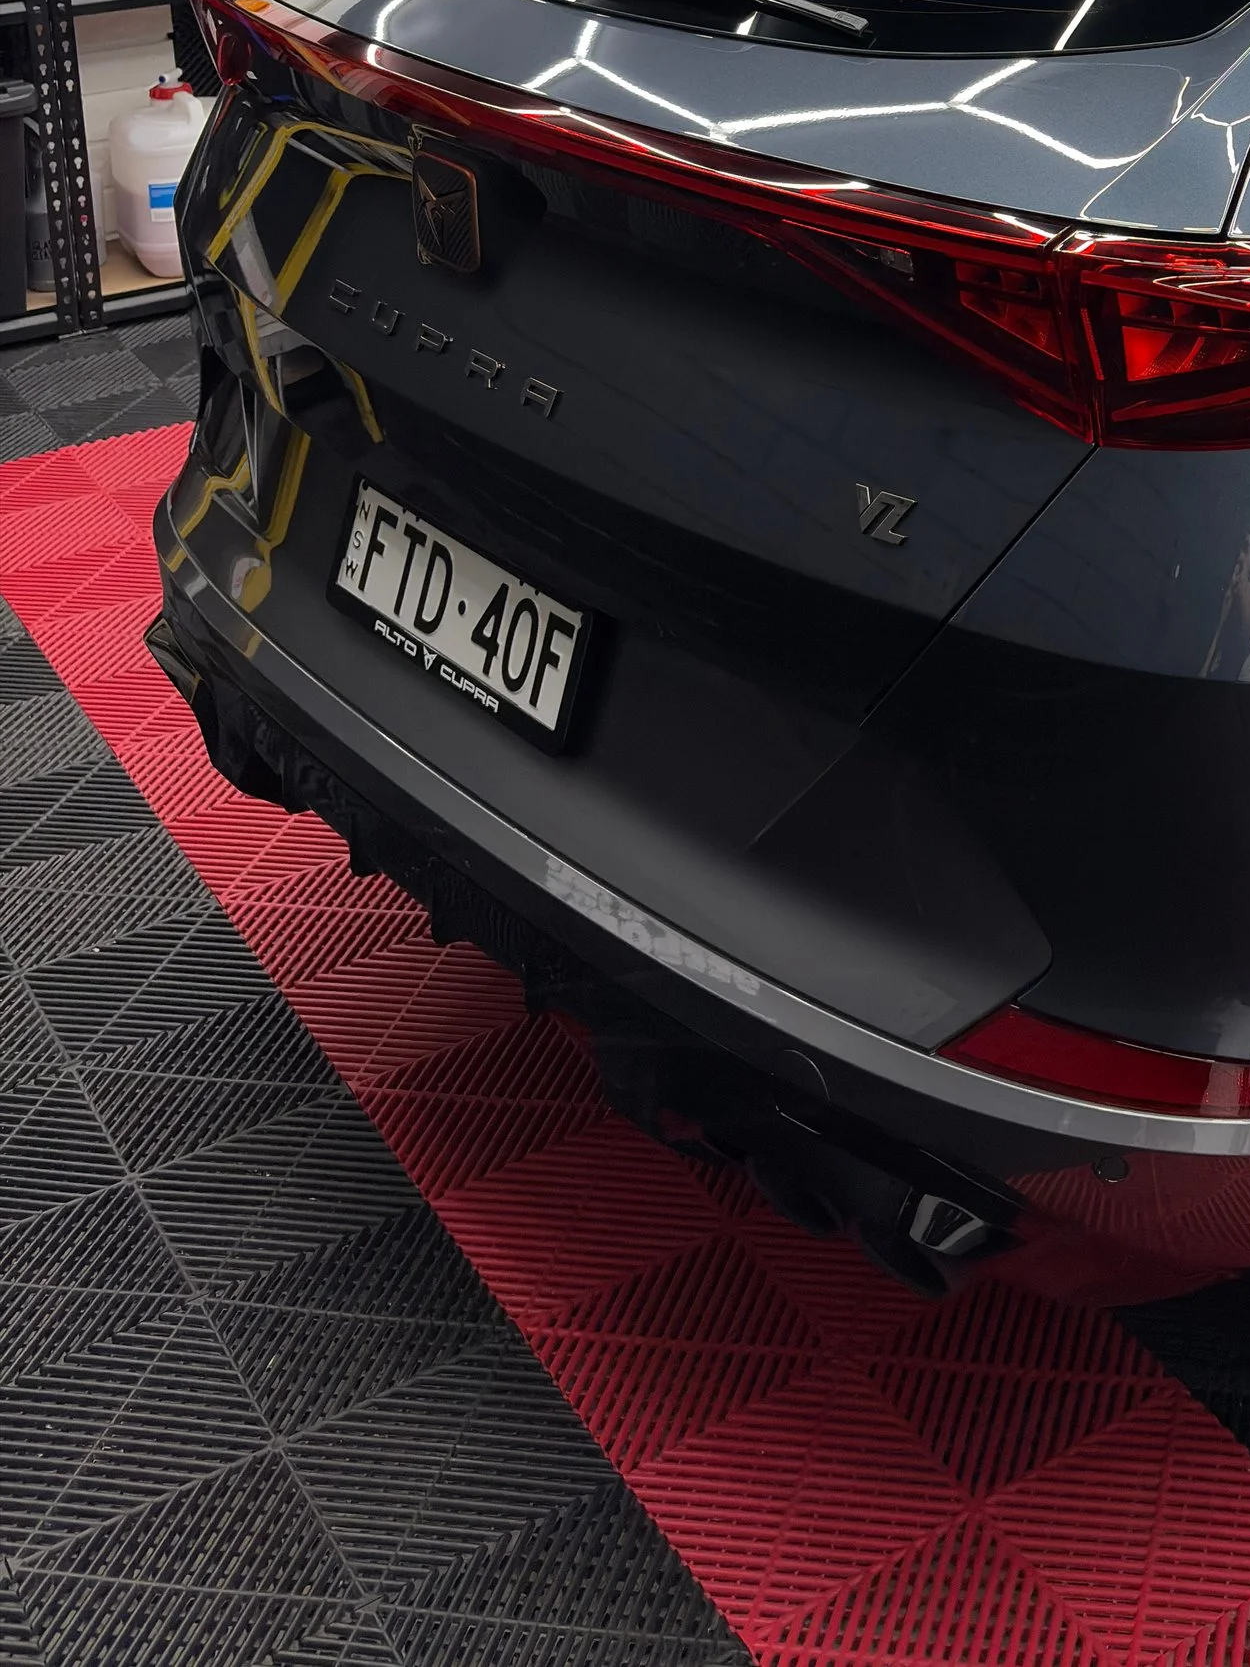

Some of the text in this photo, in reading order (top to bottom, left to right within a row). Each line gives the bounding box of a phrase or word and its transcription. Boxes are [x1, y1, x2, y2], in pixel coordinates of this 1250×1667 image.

[329, 278, 563, 420] CUPRA
[856, 482, 917, 545] VZ
[373, 619, 499, 713] ALTO CUPRA
